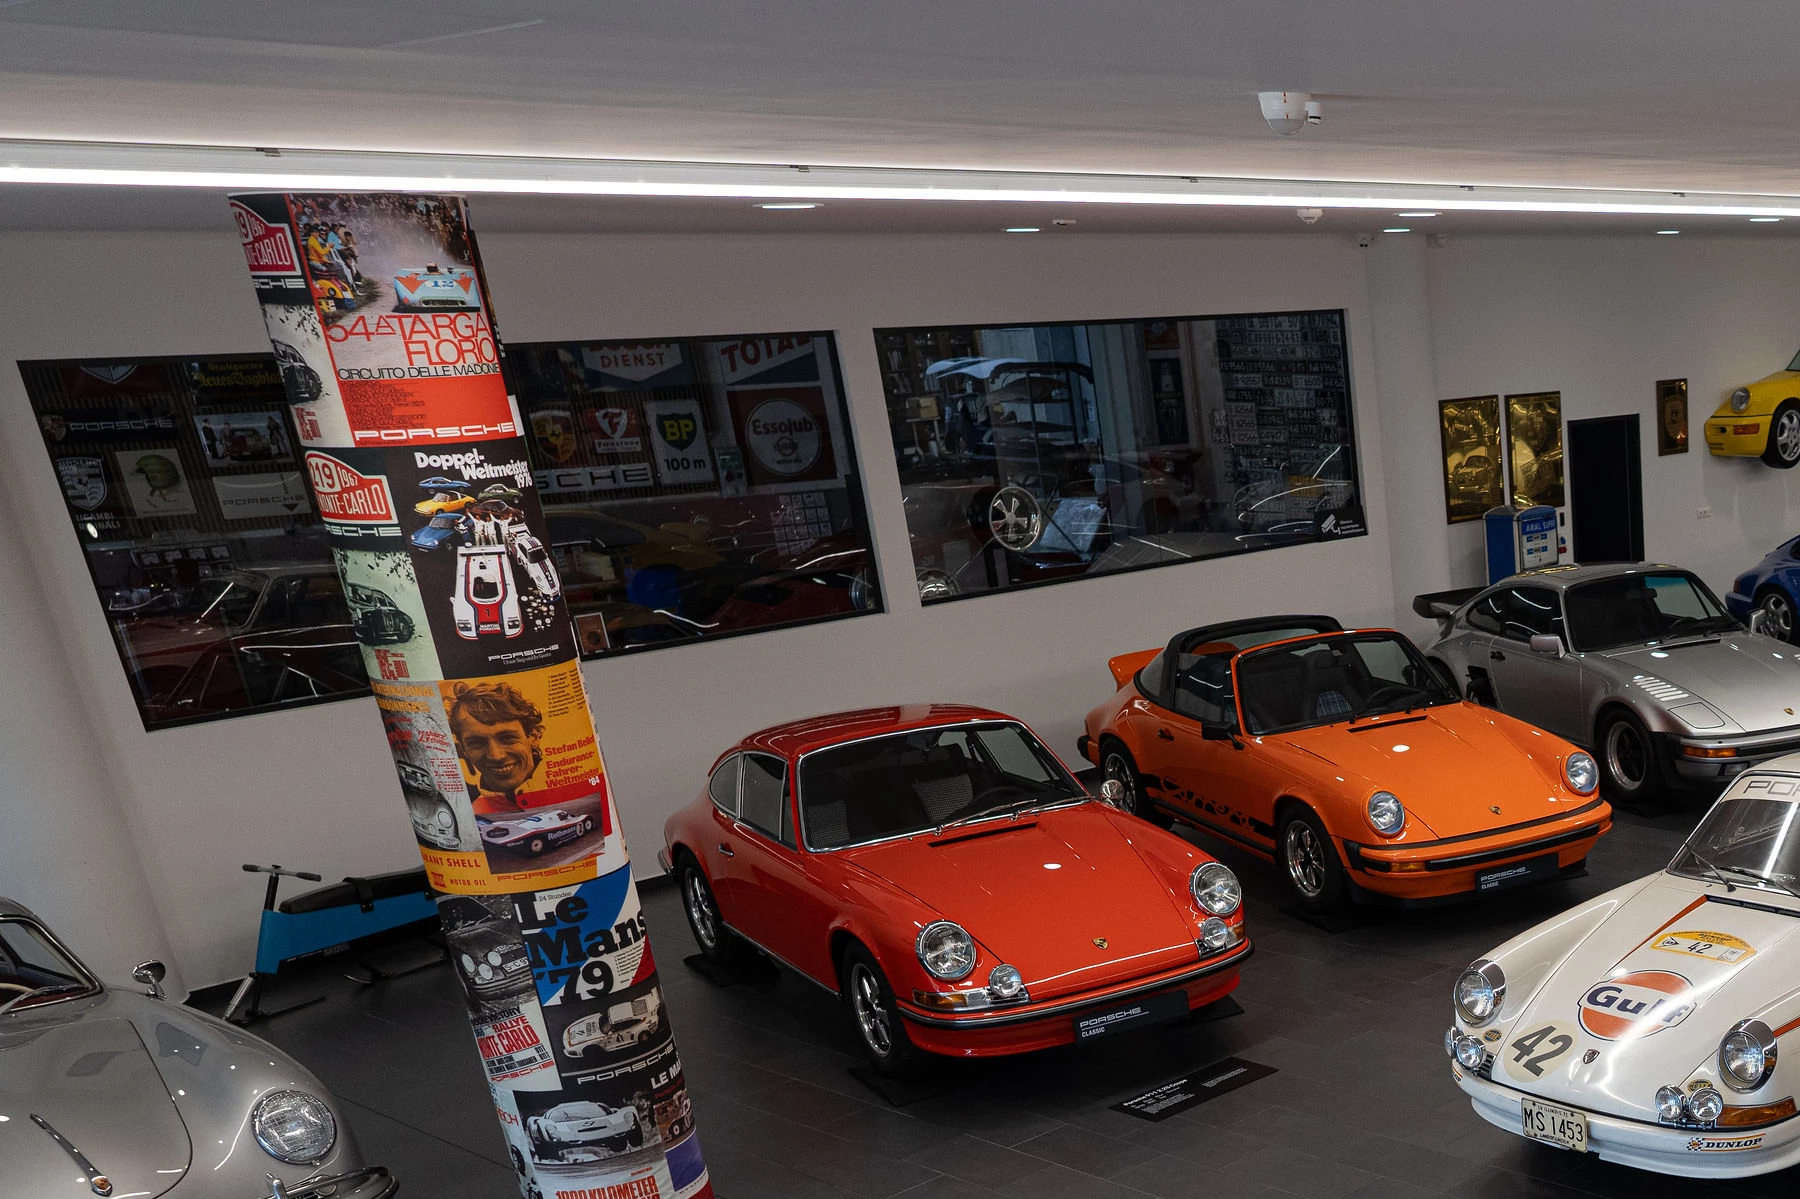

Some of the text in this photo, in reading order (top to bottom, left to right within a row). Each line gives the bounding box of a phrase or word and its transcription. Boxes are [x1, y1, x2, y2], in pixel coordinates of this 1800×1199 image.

[388, 312, 492, 342] TARGA
[404, 337, 498, 366] FLORIO
[602, 352, 665, 368] DIENST
[338, 364, 449, 380] CIRCUITO DELLE
[67, 417, 173, 432] PORSCHE
[354, 421, 516, 441] PORSCHE
[663, 419, 697, 442] BP
[751, 416, 814, 436] Essolub
[414, 448, 485, 470] Doppel-
[664, 456, 706, 472] 100 m
[338, 469, 358, 488] 1967
[460, 459, 528, 481] Weltmeister
[514, 472, 533, 488] 1976
[1525, 522, 1541, 532] ARAL
[488, 644, 560, 662] PORSCHE
[545, 743, 578, 757] Stefan
[545, 750, 595, 770] Endurance-
[545, 764, 583, 780] Fahrer-
[545, 767, 600, 789] Weltmeister
[1160, 775, 1255, 832] Carrera
[446, 858, 481, 869] SHELL
[497, 859, 597, 882] PORSCHE
[449, 879, 487, 887] MOTOR OIL
[1480, 866, 1526, 882] PORSCHE
[547, 890, 573, 900] Stunden
[518, 892, 589, 928] Le
[526, 909, 648, 969] Mans
[1687, 941, 1713, 954] 42
[1586, 985, 1691, 1024] Gulf
[492, 1016, 529, 1033] RALLYE
[1080, 1007, 1142, 1028] PORSCHE
[495, 1024, 541, 1054] CARLO
[1081, 1027, 1106, 1038] CLASSIC
[1511, 1025, 1574, 1077] 42
[578, 1045, 674, 1085] PORSCHE
[651, 1071, 669, 1089] LE
[1524, 1107, 1584, 1142] MS 1453
[1706, 1137, 1763, 1148] DUNLOP
